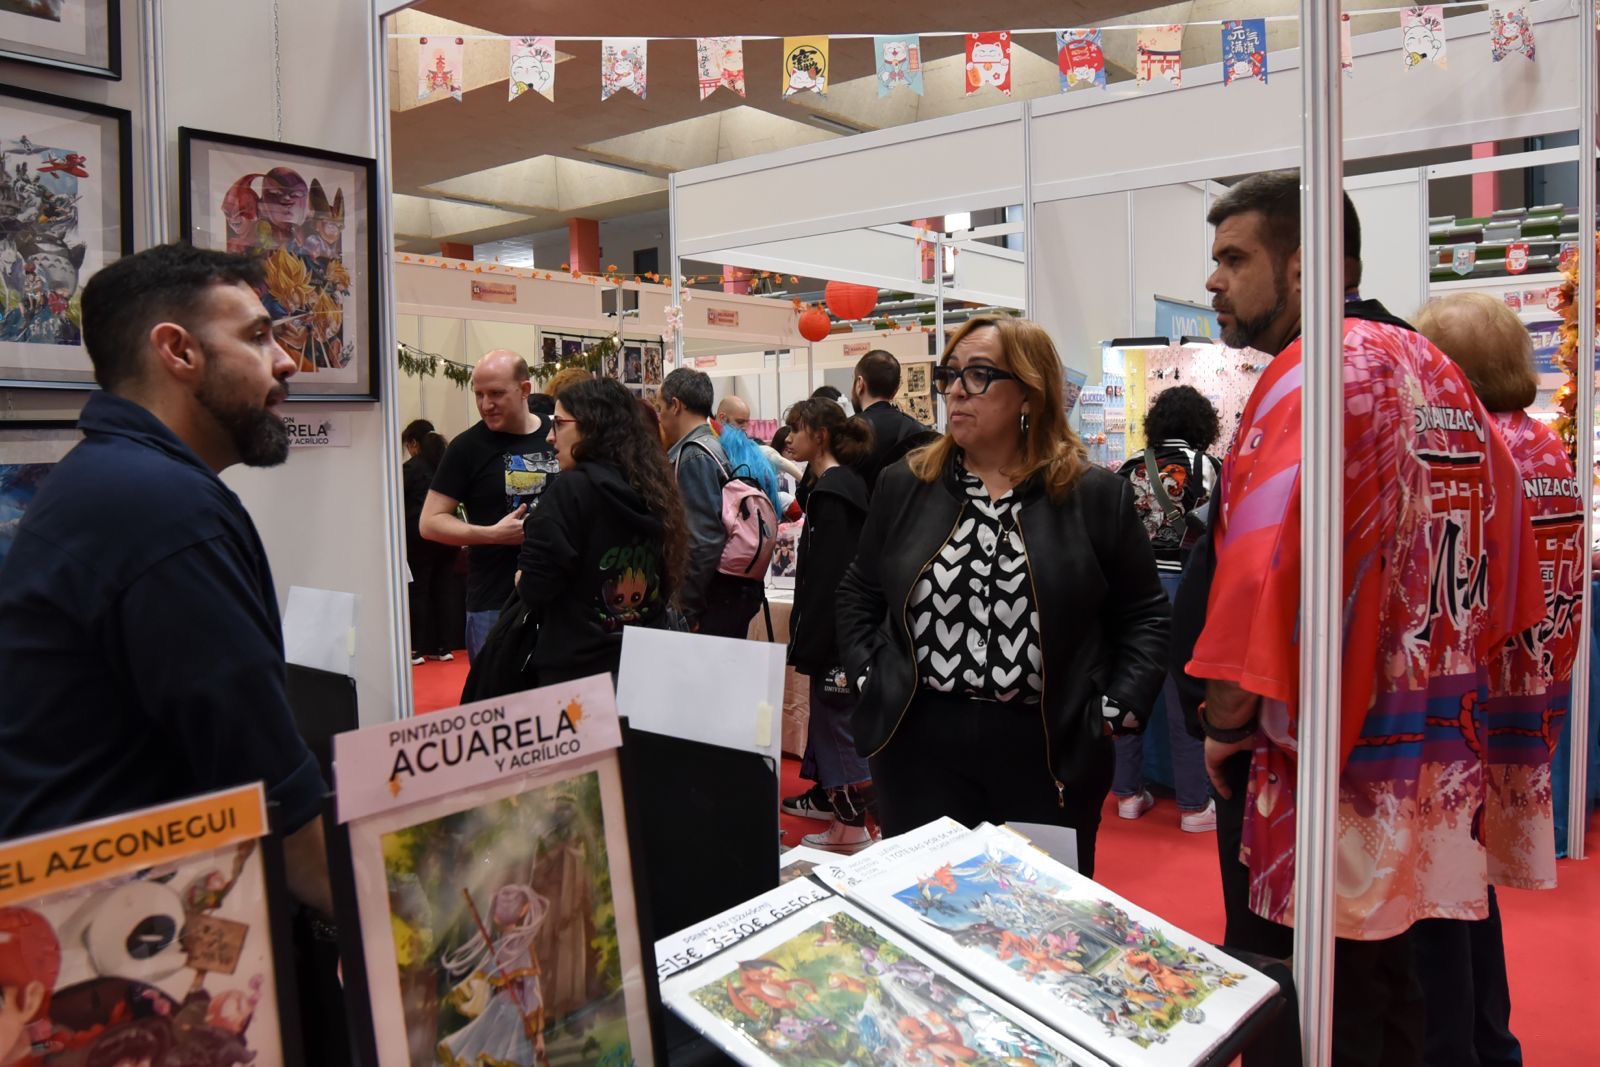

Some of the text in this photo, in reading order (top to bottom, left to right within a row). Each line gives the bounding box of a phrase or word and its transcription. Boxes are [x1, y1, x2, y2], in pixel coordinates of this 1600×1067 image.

[281, 416, 295, 424] ON
[389, 706, 506, 747] PINTADO CON
[389, 709, 576, 783] ACUARELA
[495, 739, 581, 773] Y ACRÍLICO
[45, 807, 237, 878] AZCONEGUI
